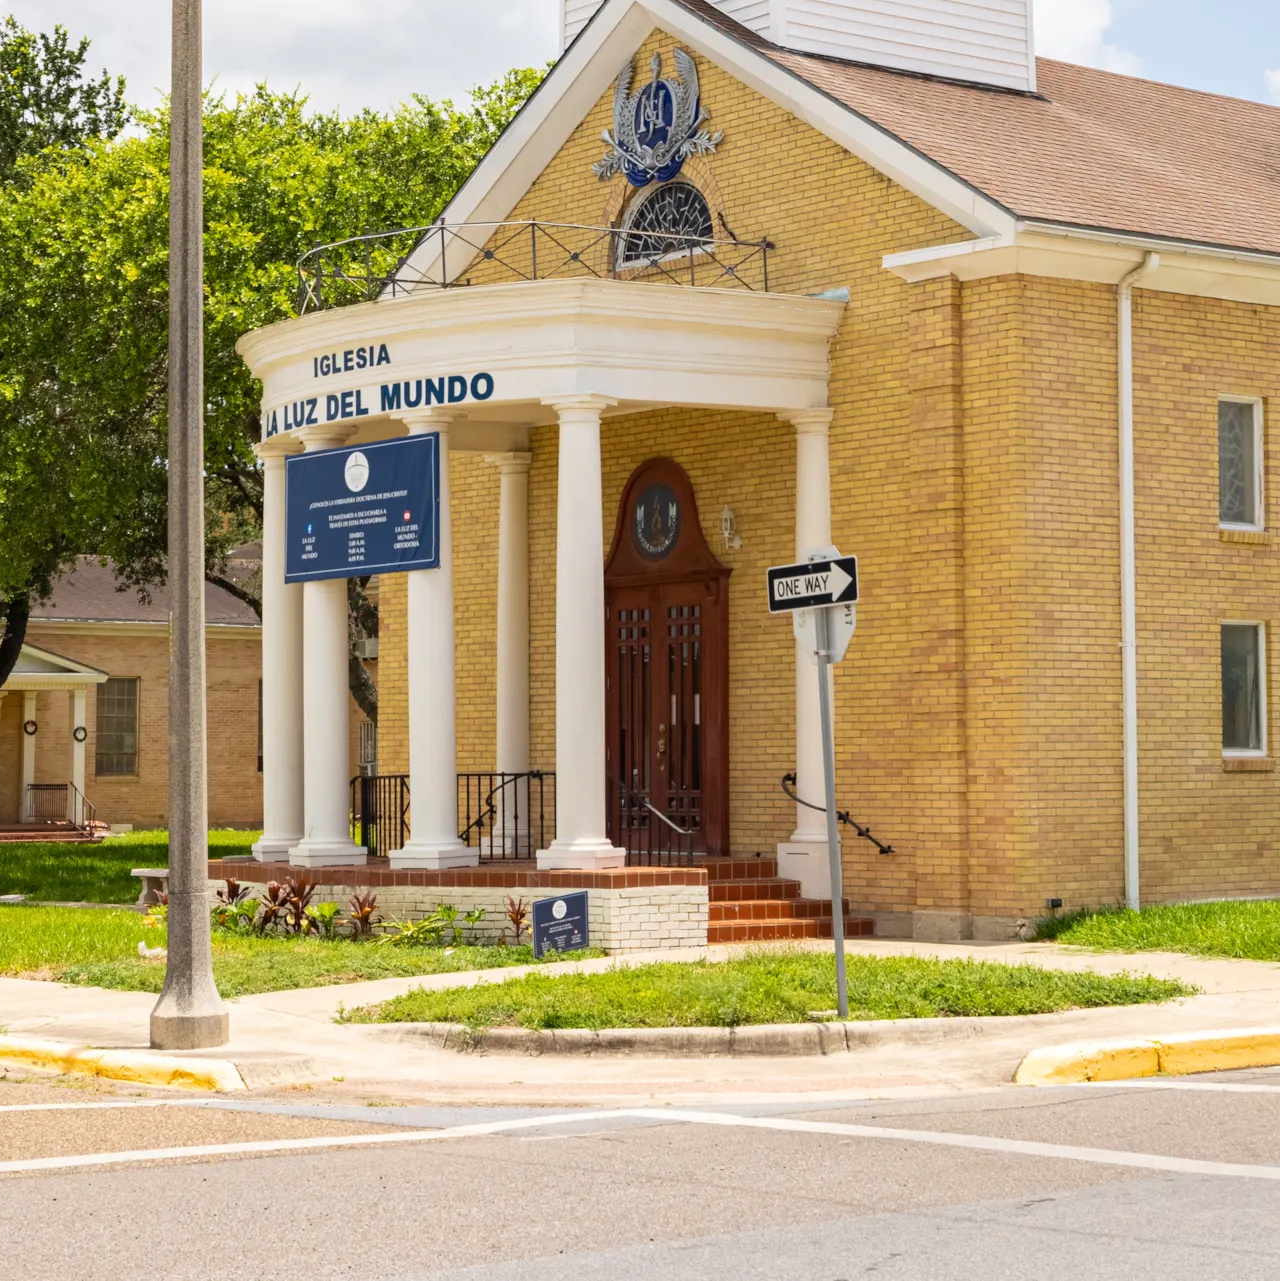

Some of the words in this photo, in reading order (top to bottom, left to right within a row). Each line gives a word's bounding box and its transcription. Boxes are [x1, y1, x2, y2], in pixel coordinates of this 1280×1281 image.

[313, 343, 391, 378] IGLESIA
[266, 409, 278, 438] LA
[283, 397, 318, 431] LUZ
[326, 389, 369, 422] DEL
[380, 372, 494, 412] MUNDO
[301, 552, 318, 560] MUNDO
[777, 578, 801, 598] ONE
[804, 574, 829, 594] WAY
